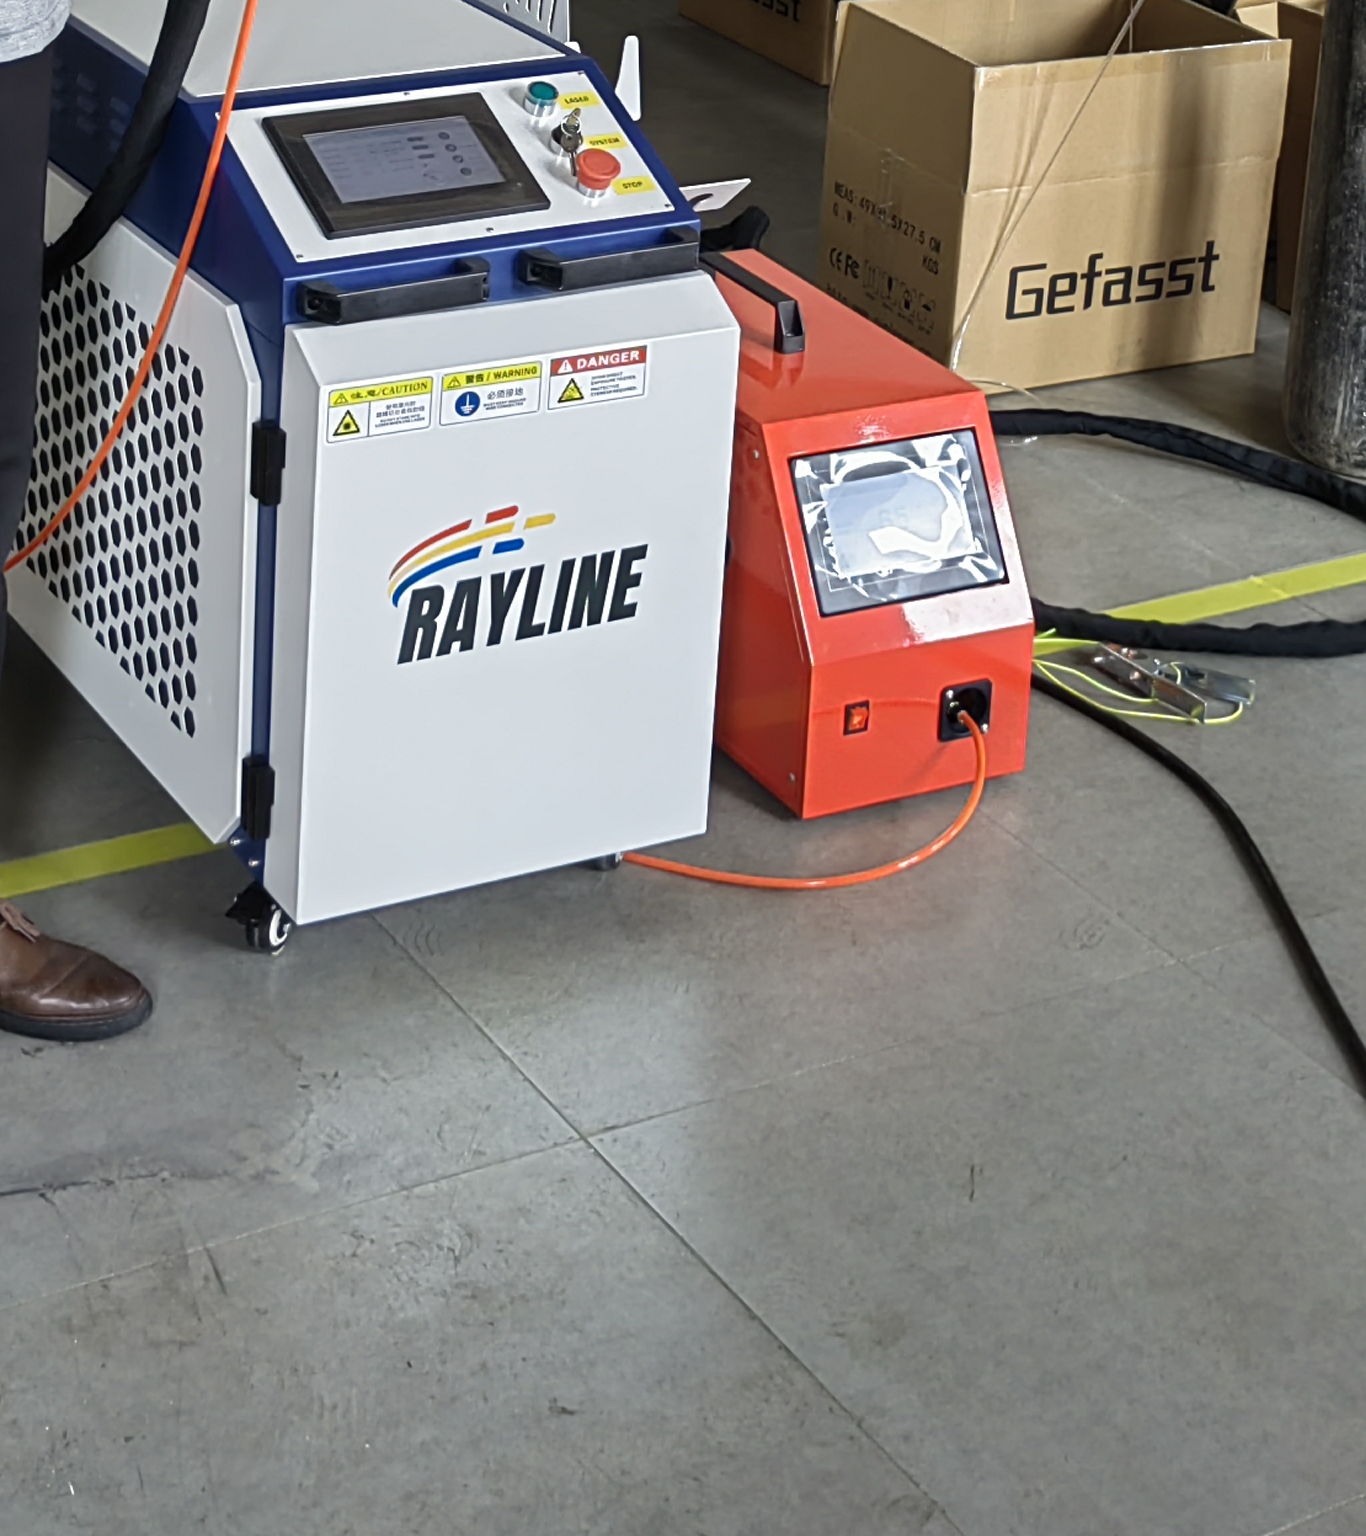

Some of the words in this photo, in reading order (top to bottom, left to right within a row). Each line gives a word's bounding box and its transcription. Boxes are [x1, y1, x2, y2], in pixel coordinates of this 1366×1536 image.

[564, 95, 590, 105] LASER
[589, 136, 620, 147] SYSTEM
[622, 180, 643, 190] STOP
[1005, 240, 1220, 321] Gefasst
[576, 350, 641, 370] DANGER
[494, 365, 538, 380] WARNING
[397, 543, 649, 665] RAYLINE
